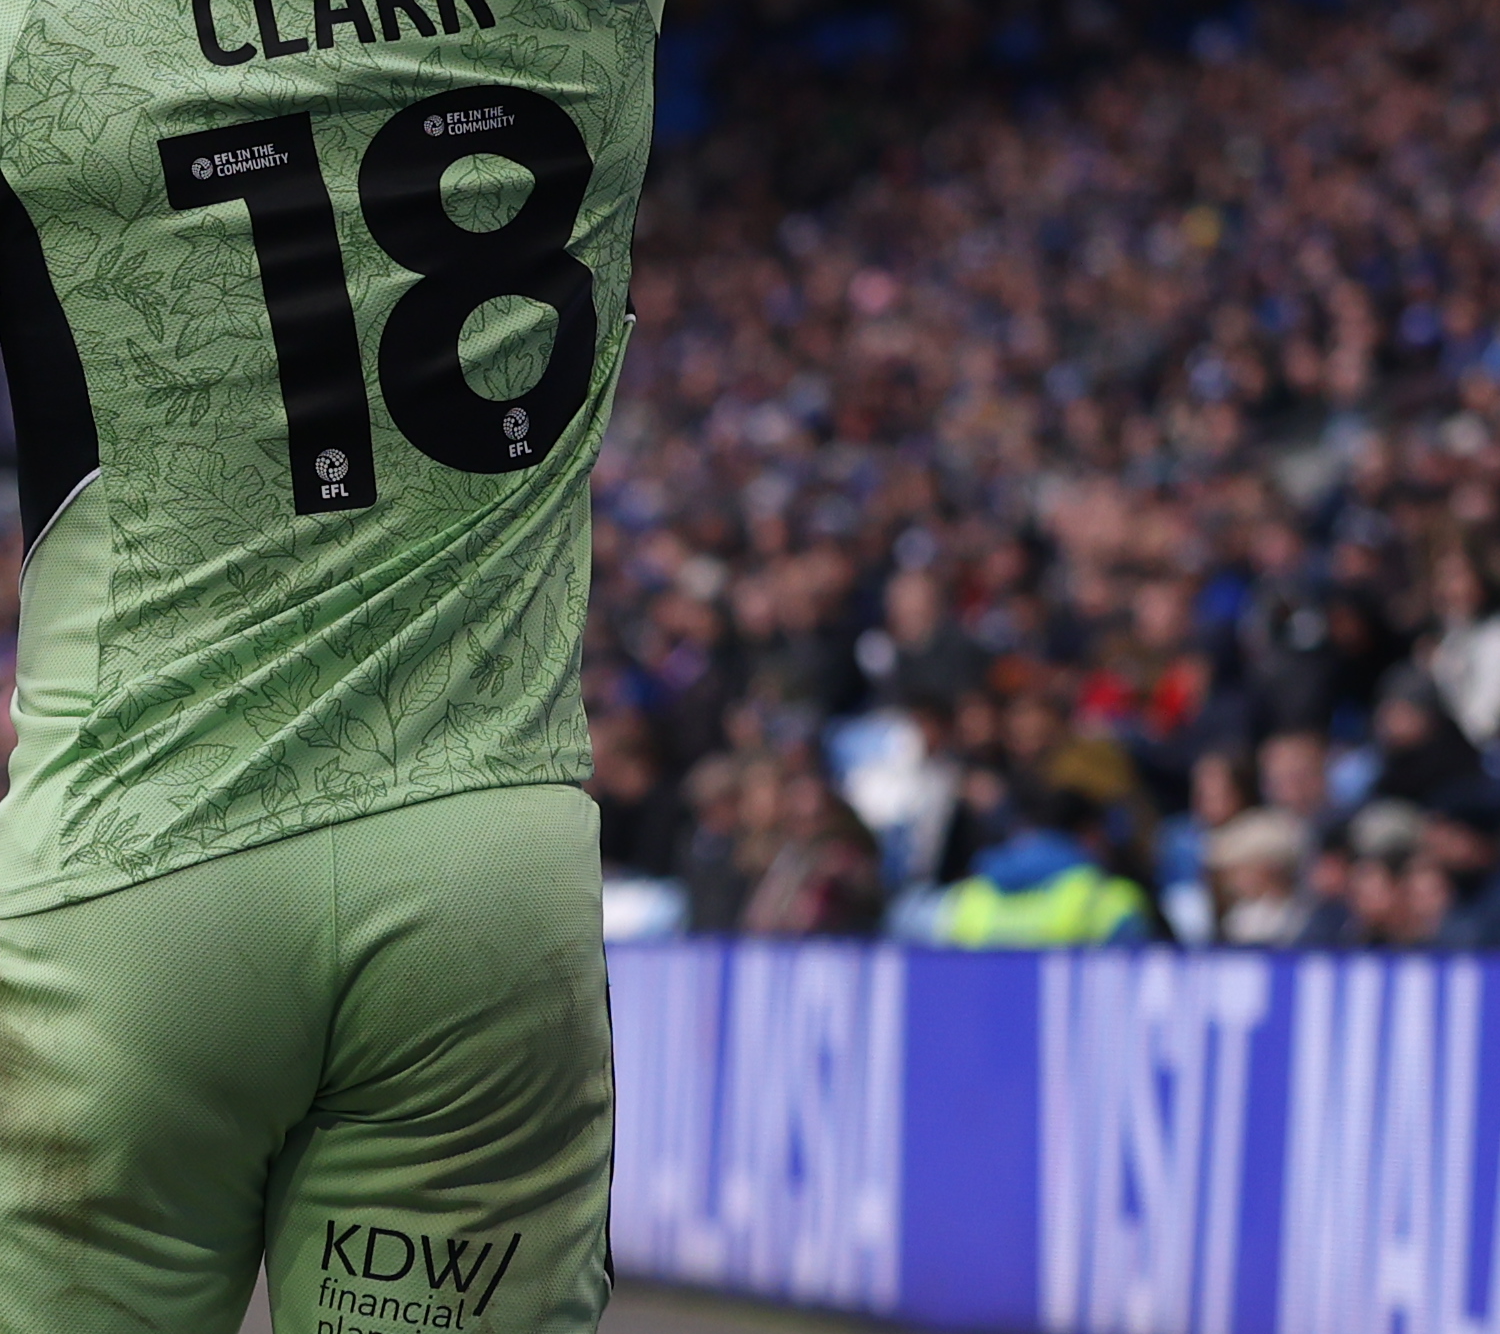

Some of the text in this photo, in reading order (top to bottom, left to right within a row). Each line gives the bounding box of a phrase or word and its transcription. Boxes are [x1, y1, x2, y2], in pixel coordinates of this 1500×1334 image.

[446, 105, 504, 124] EFL IN THE
[448, 114, 515, 136] COMMUNITY
[213, 143, 276, 166] EFL IN THE
[216, 152, 289, 177] COMMUNITY
[156, 84, 598, 517] 18
[508, 440, 533, 459] EFL
[320, 483, 350, 500] EFL
[318, 1276, 465, 1331] financial
